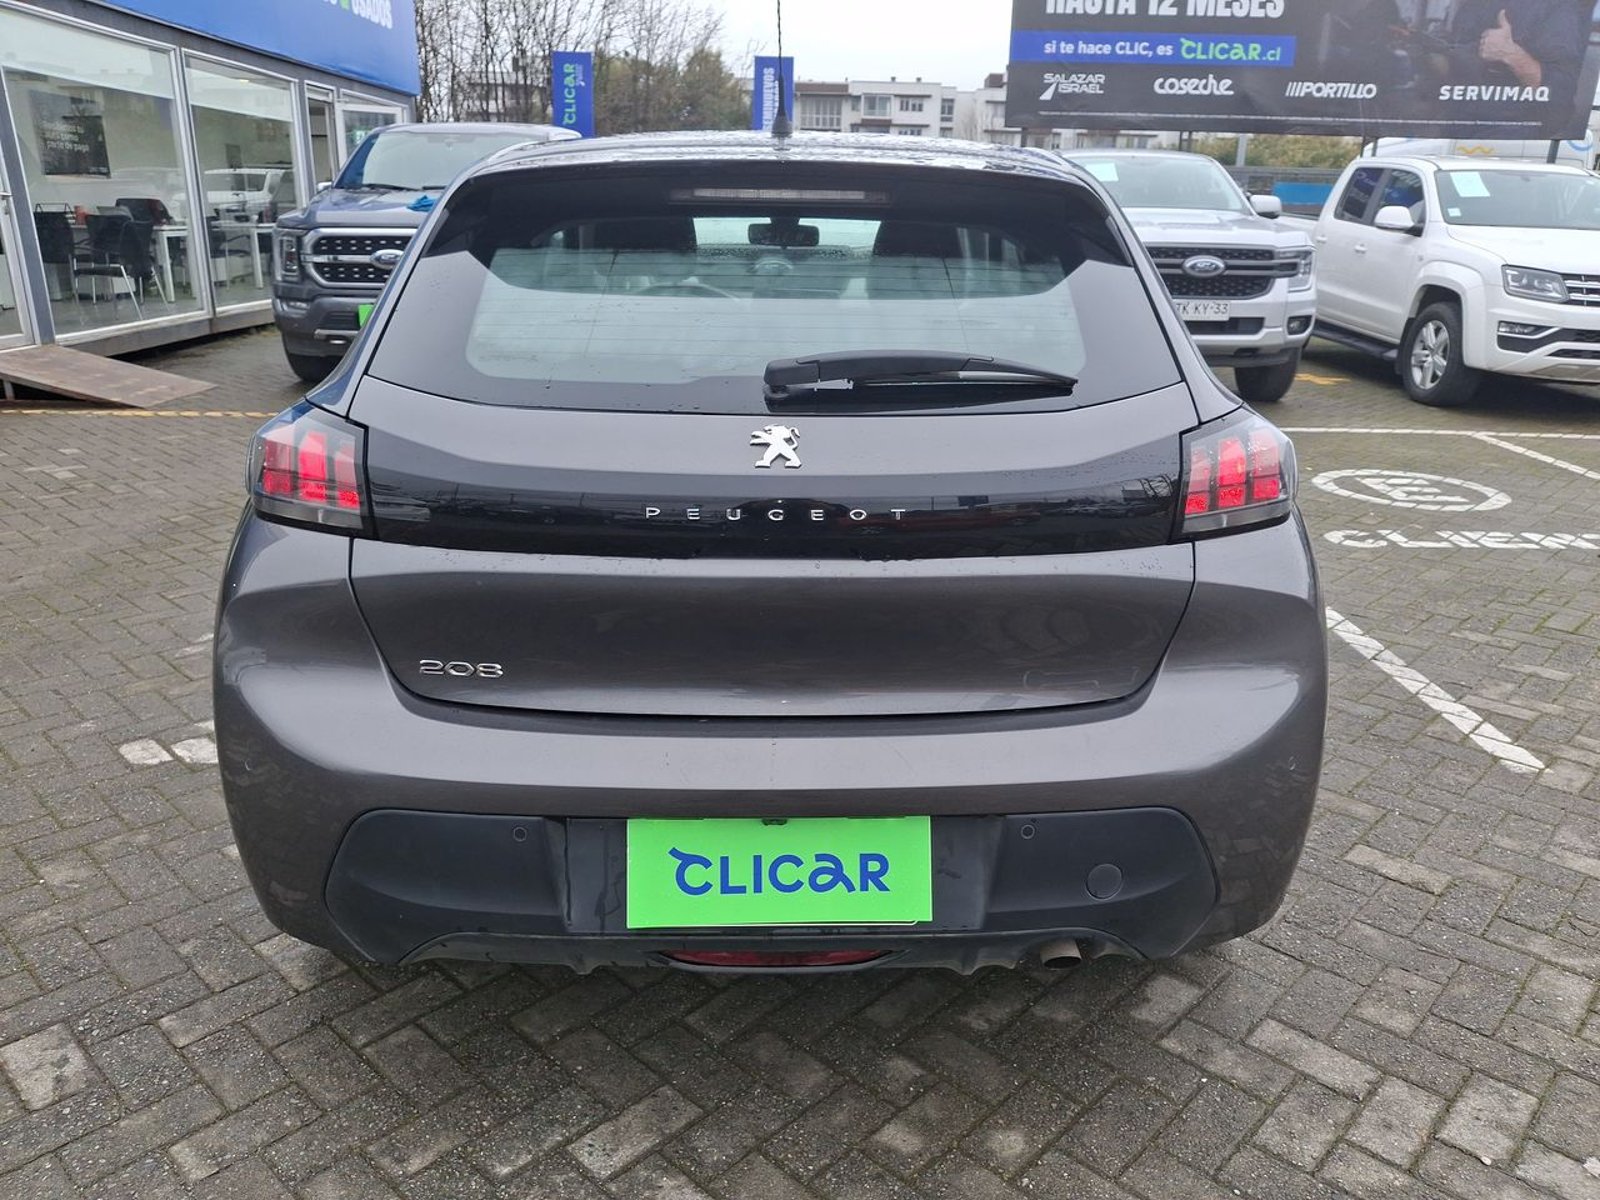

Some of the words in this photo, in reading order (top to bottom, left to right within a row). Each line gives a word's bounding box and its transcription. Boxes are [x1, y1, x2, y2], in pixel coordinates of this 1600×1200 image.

[1045, 0, 1136, 16] HASTA
[1148, 0, 1178, 17] 12
[1186, 0, 1285, 18] MESES
[1044, 40, 1056, 54] si
[1060, 42, 1074, 54] te
[1077, 41, 1111, 55] hace
[1115, 41, 1153, 57] CLIC,
[1156, 44, 1173, 56] es
[1044, 73, 1105, 84] SALAZAR
[1058, 83, 1104, 94] ISRAEL
[1438, 84, 1550, 102] SERVIMAQ
[645, 506, 906, 521] PEUGEOT
[419, 659, 504, 678] 208
